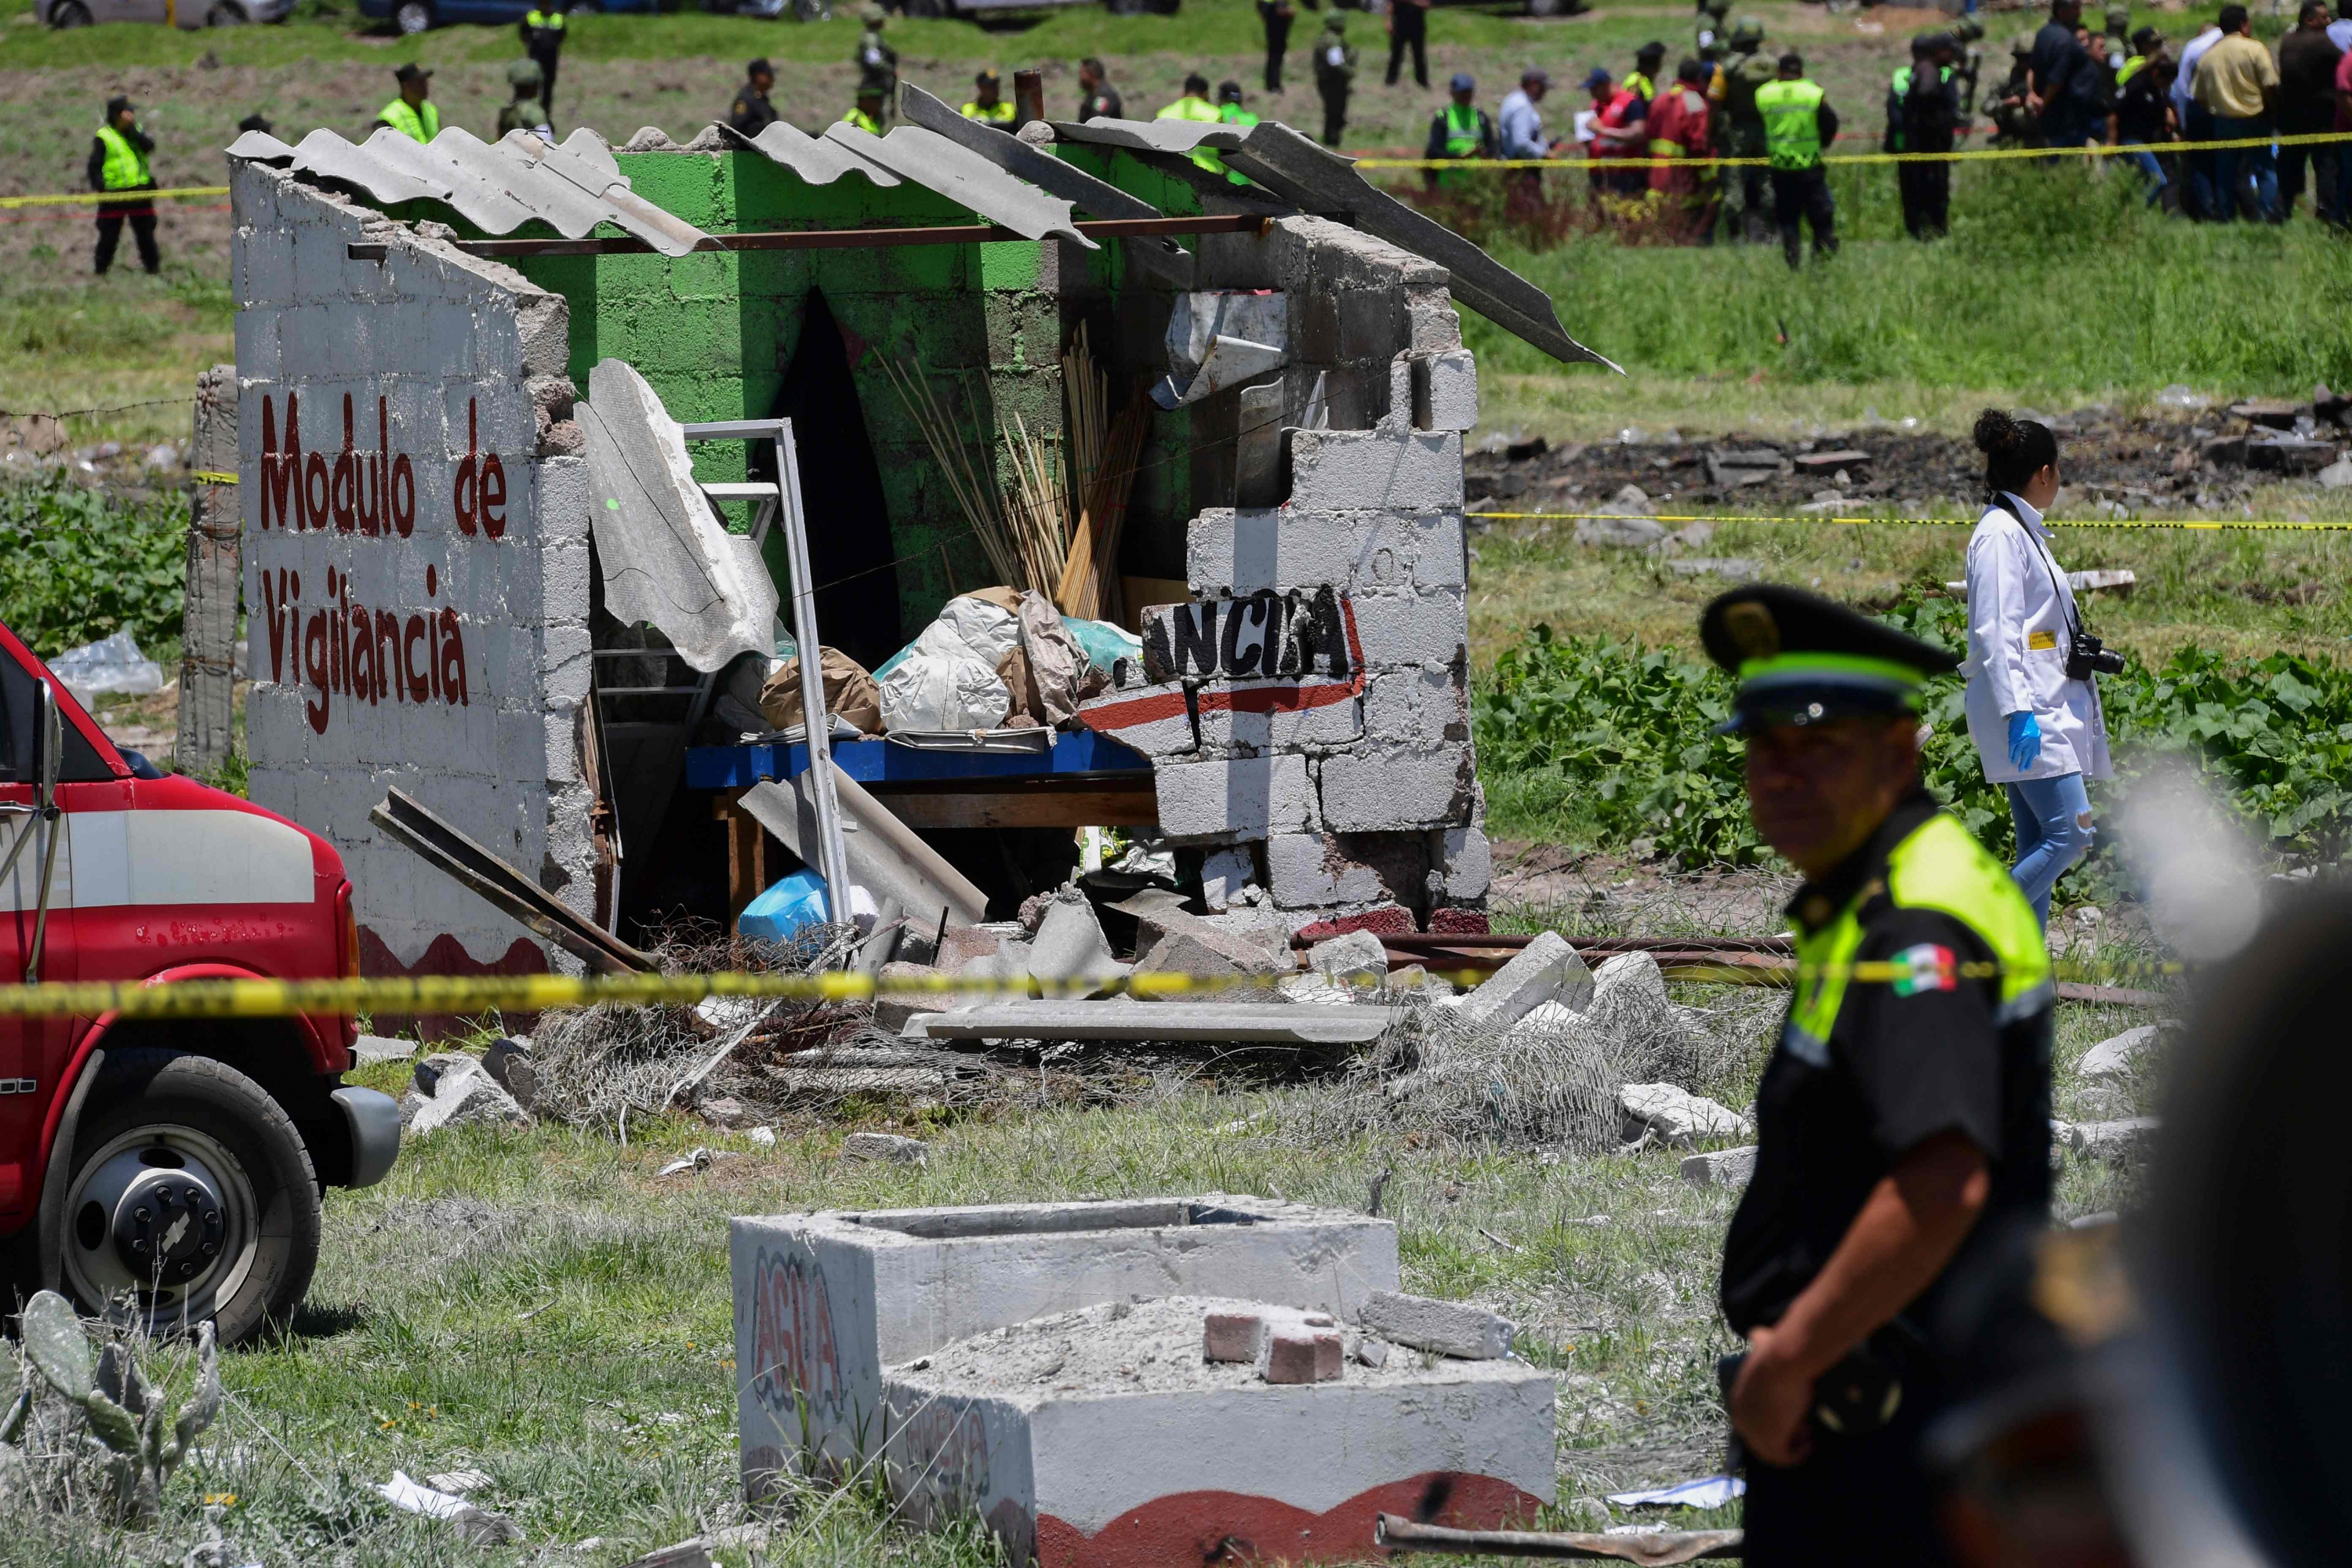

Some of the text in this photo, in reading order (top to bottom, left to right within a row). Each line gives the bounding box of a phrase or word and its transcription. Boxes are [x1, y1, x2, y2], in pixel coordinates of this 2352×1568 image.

[260, 391, 506, 540] Modulo de
[263, 564, 469, 735] Vigilancia
